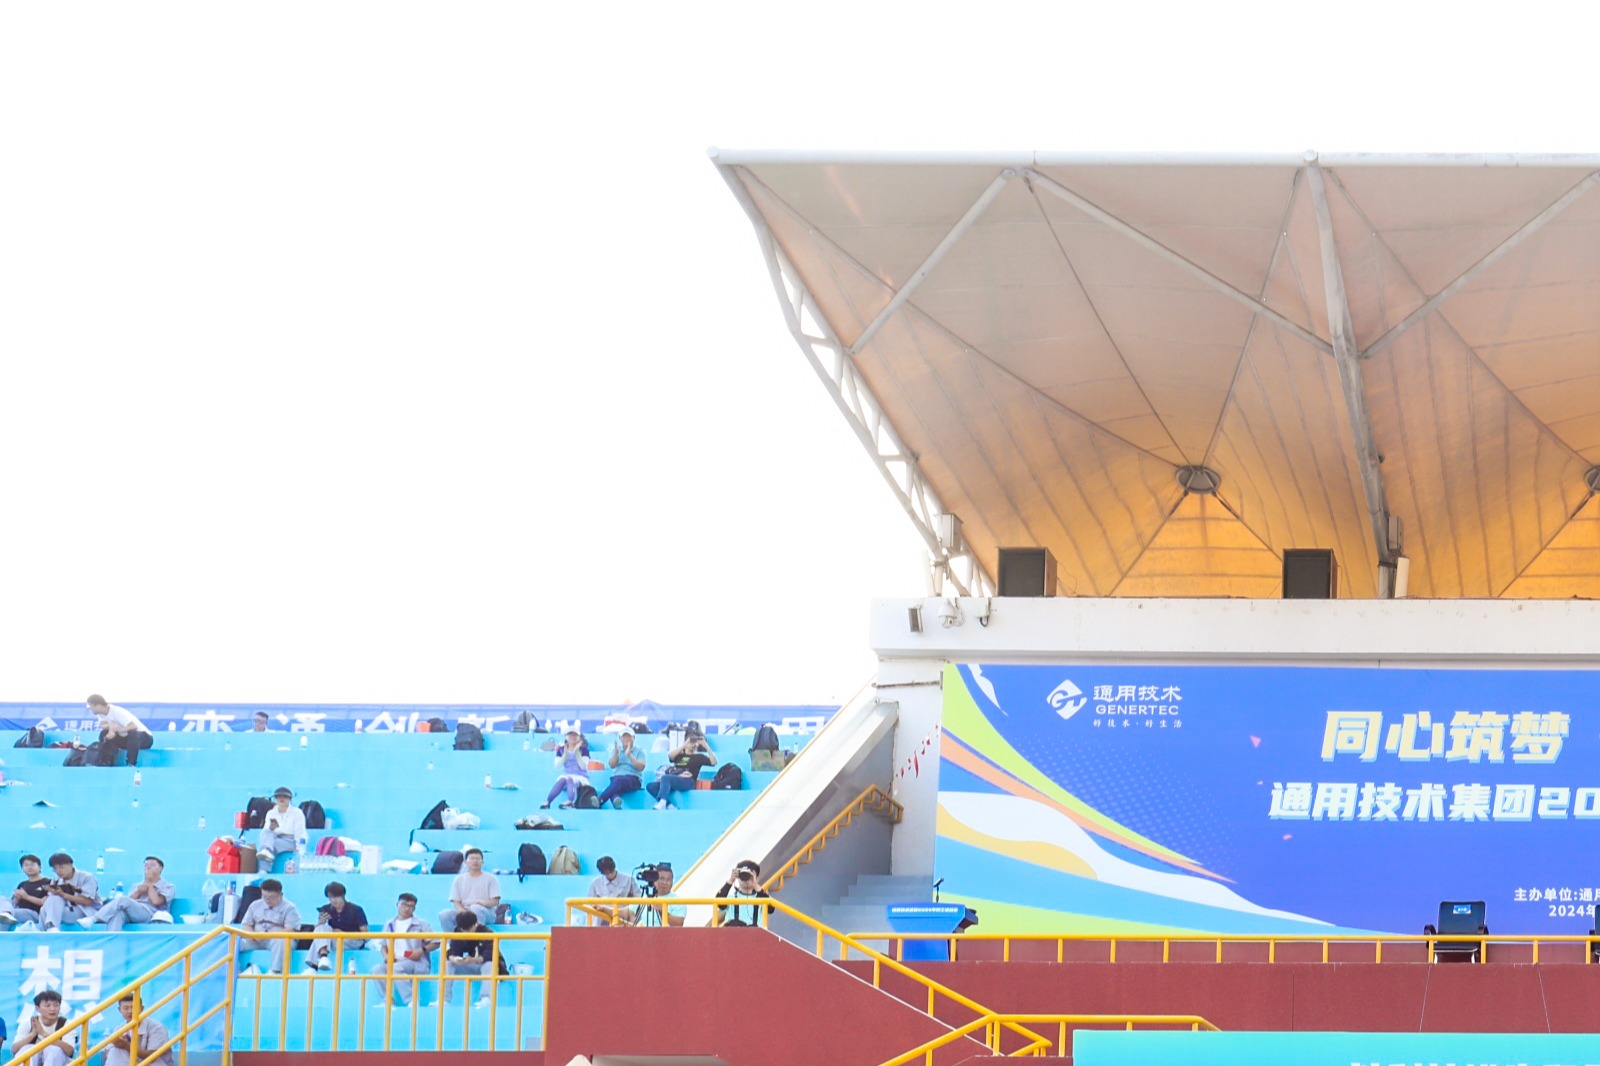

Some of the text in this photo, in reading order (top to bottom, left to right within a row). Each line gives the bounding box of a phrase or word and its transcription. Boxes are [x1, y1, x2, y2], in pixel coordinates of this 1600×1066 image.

[1093, 685, 1183, 702] 通用技术
[1096, 704, 1179, 715] GENERTEC
